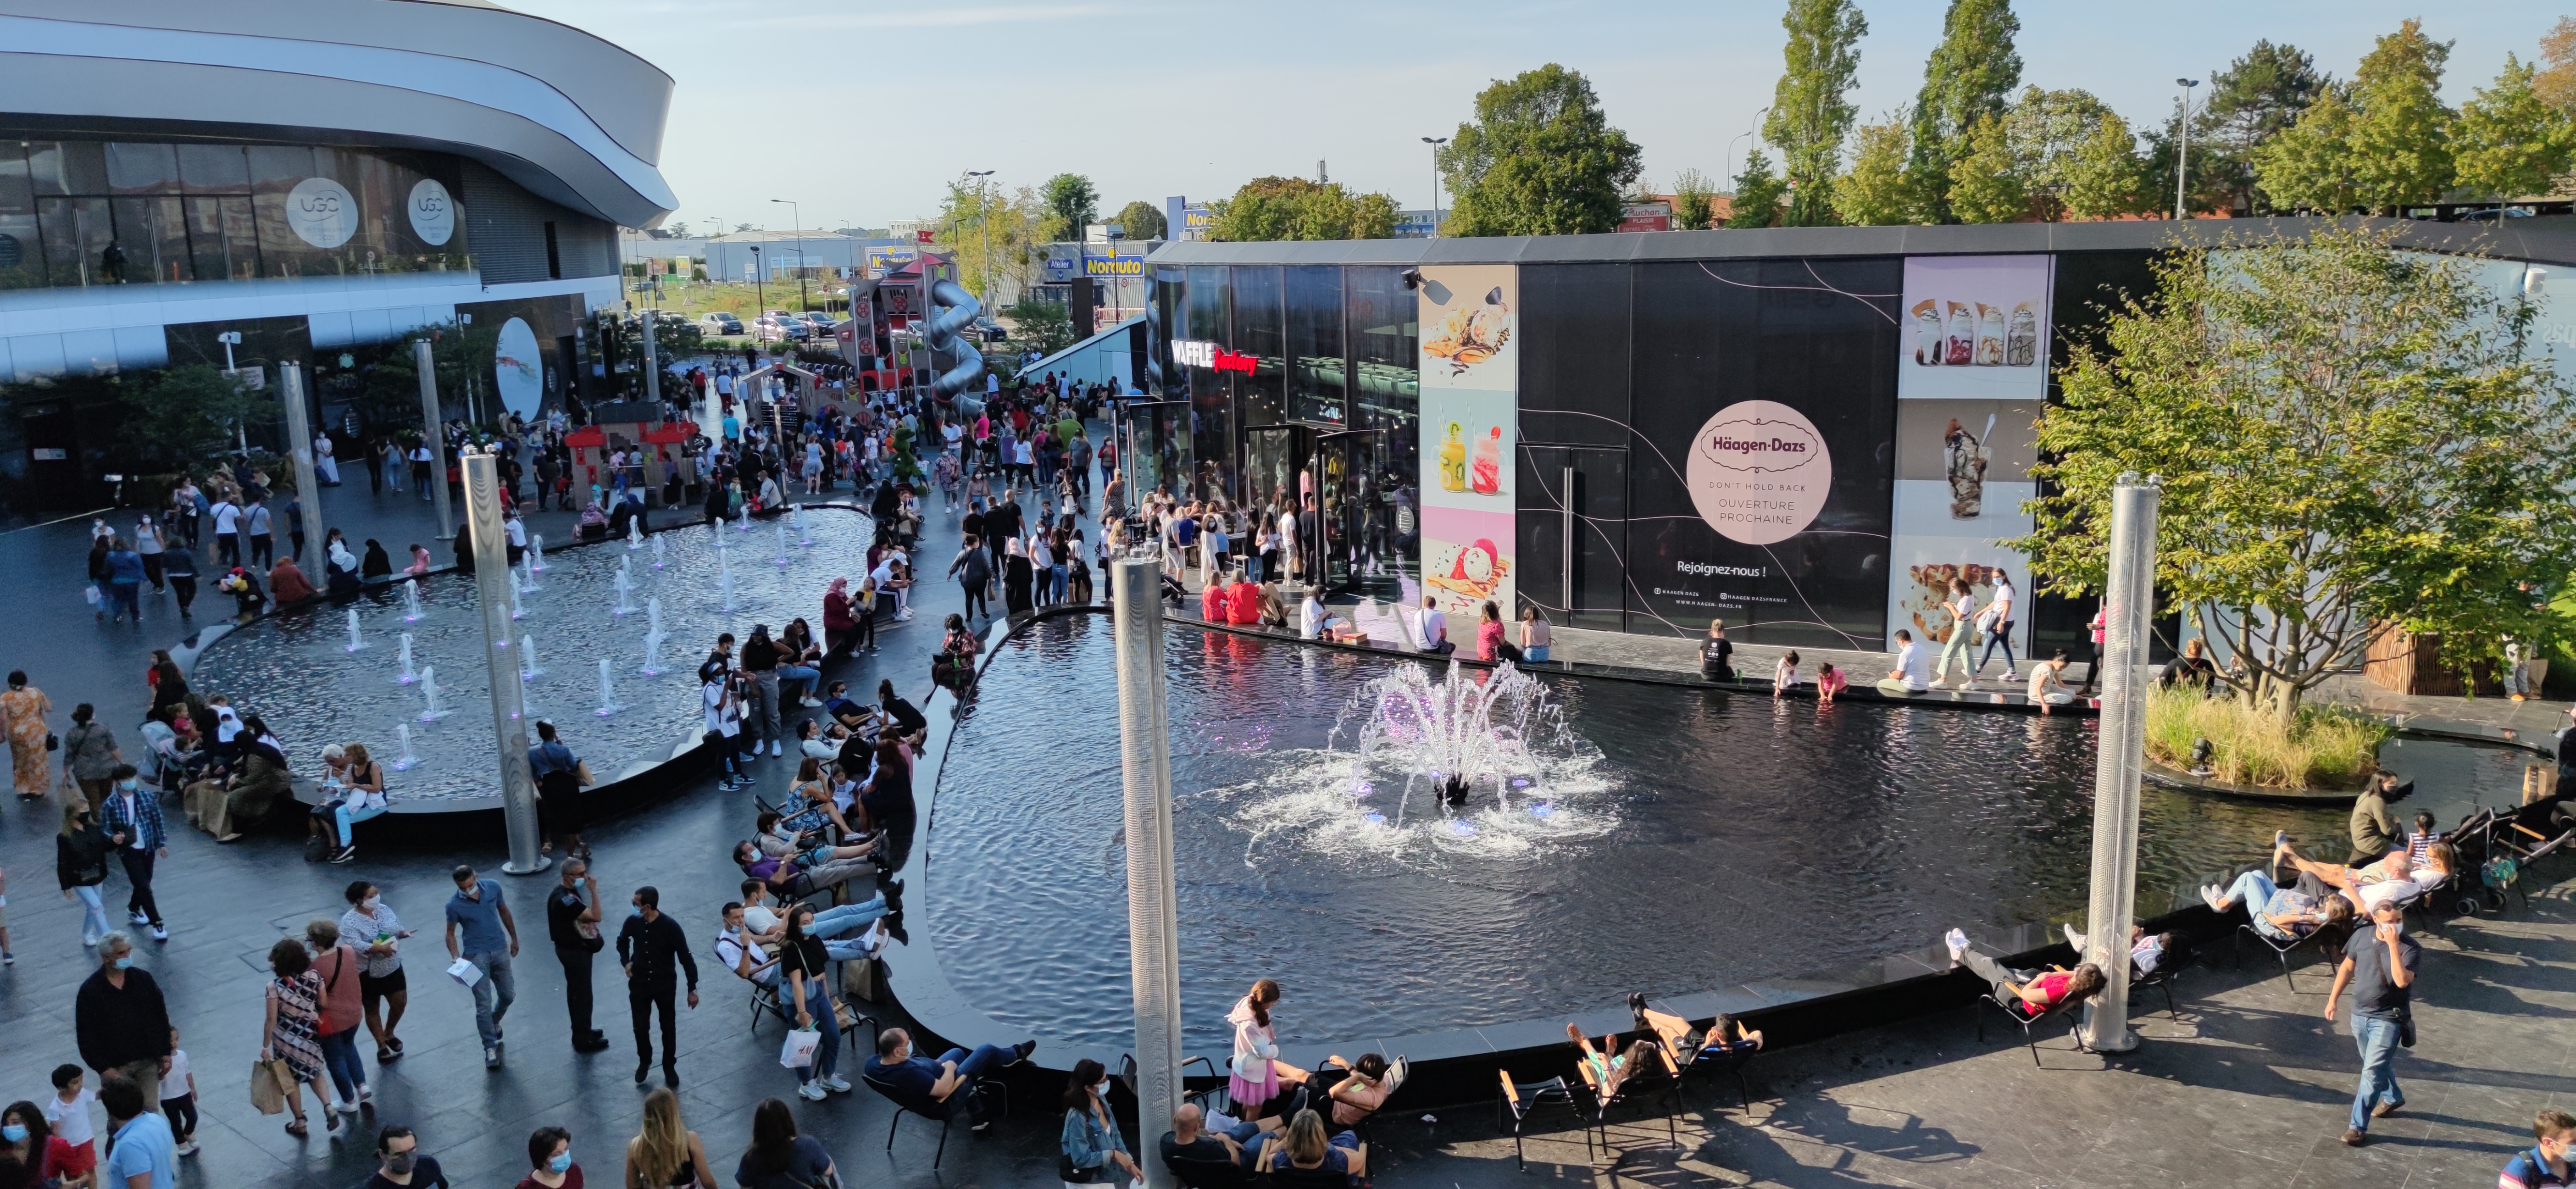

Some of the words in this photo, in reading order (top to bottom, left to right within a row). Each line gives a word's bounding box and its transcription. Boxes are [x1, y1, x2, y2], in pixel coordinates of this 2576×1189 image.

[300, 197, 339, 212] UGC
[417, 197, 443, 212] UGC
[1050, 260, 1070, 268] Atelier
[1087, 259, 1141, 274] Norauto
[1171, 340, 1216, 367] WAFFLE
[1713, 436, 1806, 455] Häagen-Dazs
[1719, 499, 1795, 511] OUVERTURE
[1720, 513, 1793, 524] PROCHAINE
[1677, 561, 1760, 577] Rejoignez-nous
[797, 1045, 813, 1056] H&M
